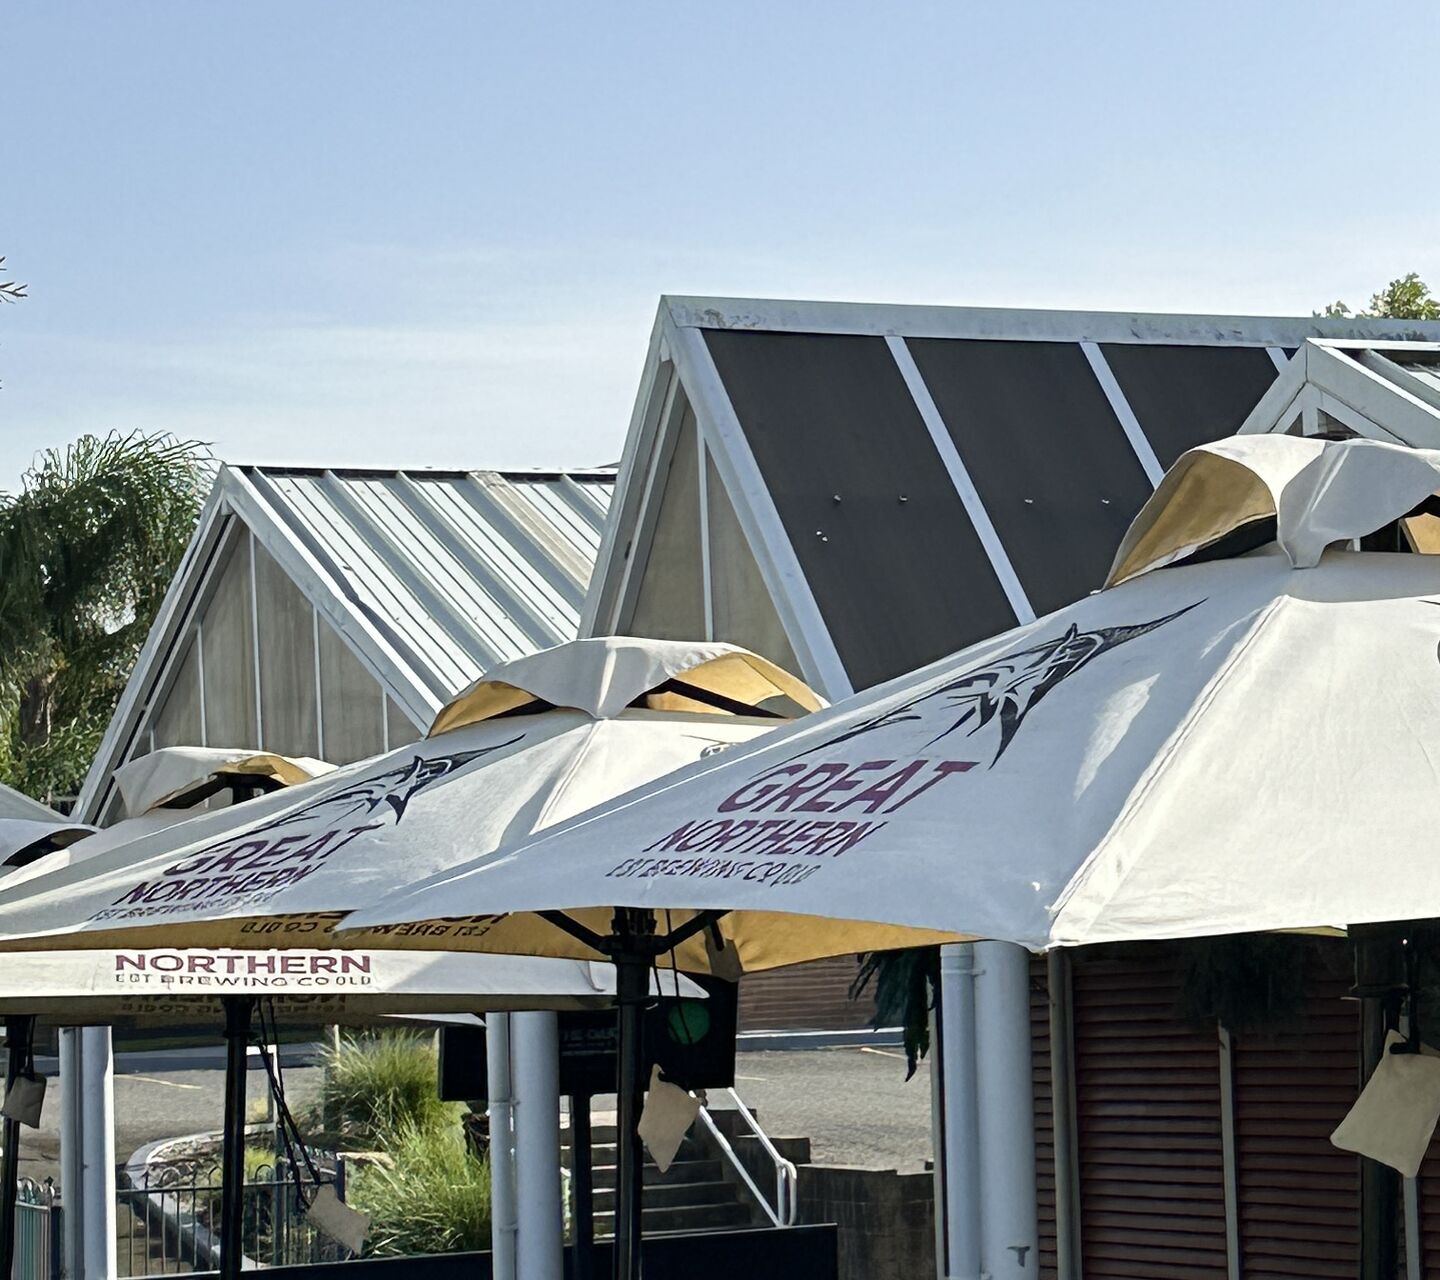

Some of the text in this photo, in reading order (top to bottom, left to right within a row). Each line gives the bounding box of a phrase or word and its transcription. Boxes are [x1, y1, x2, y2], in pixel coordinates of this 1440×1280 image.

[717, 759, 981, 815] GREAT
[163, 822, 385, 876] GREAT
[642, 818, 889, 858] NORTHERN
[112, 862, 327, 905] NORTHERN
[115, 954, 372, 974] NORTHERN
